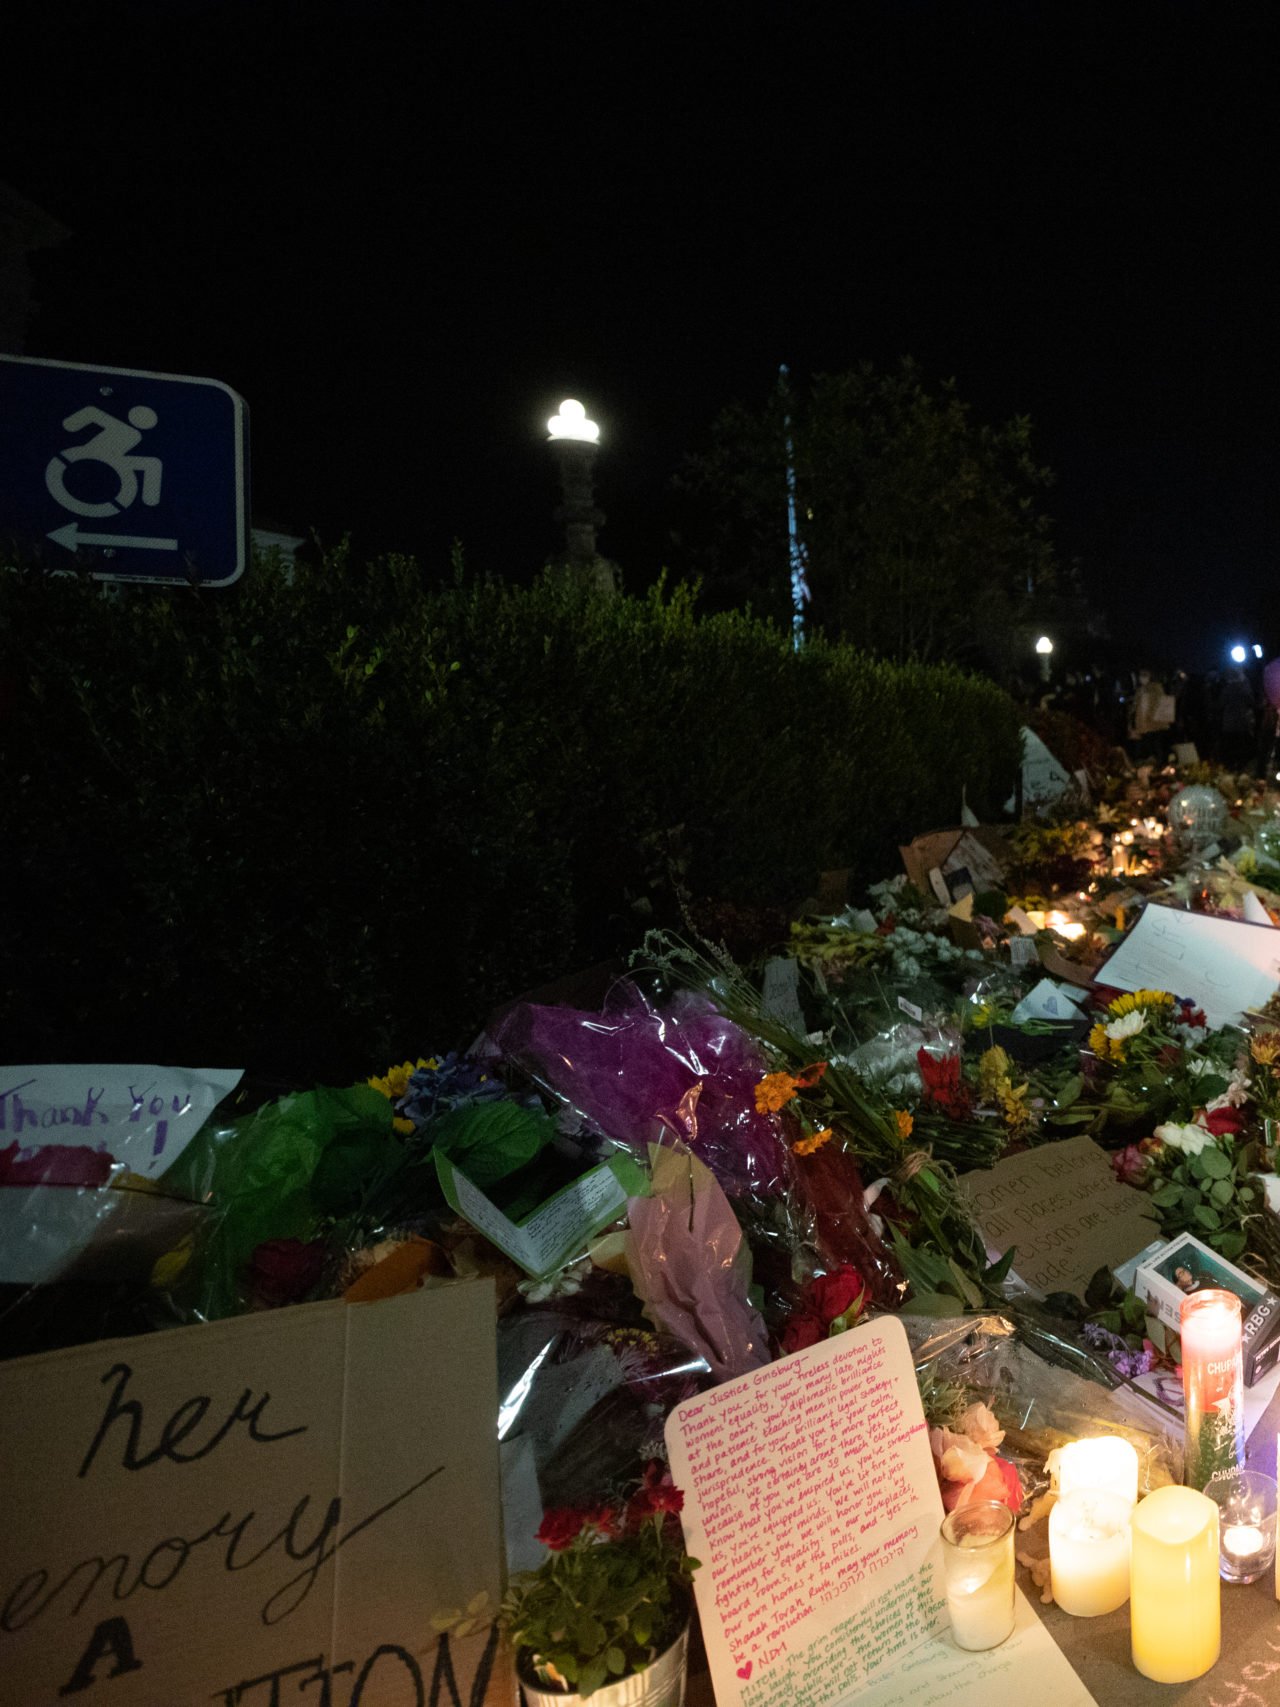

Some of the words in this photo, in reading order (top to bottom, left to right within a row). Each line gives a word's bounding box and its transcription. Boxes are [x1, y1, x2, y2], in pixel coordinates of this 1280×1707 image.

[0, 1079, 109, 1133] Thank
[129, 1081, 193, 1123] You
[974, 1174, 1041, 1211] omen
[1243, 1304, 1271, 1334] RBG
[77, 1363, 308, 1478] her
